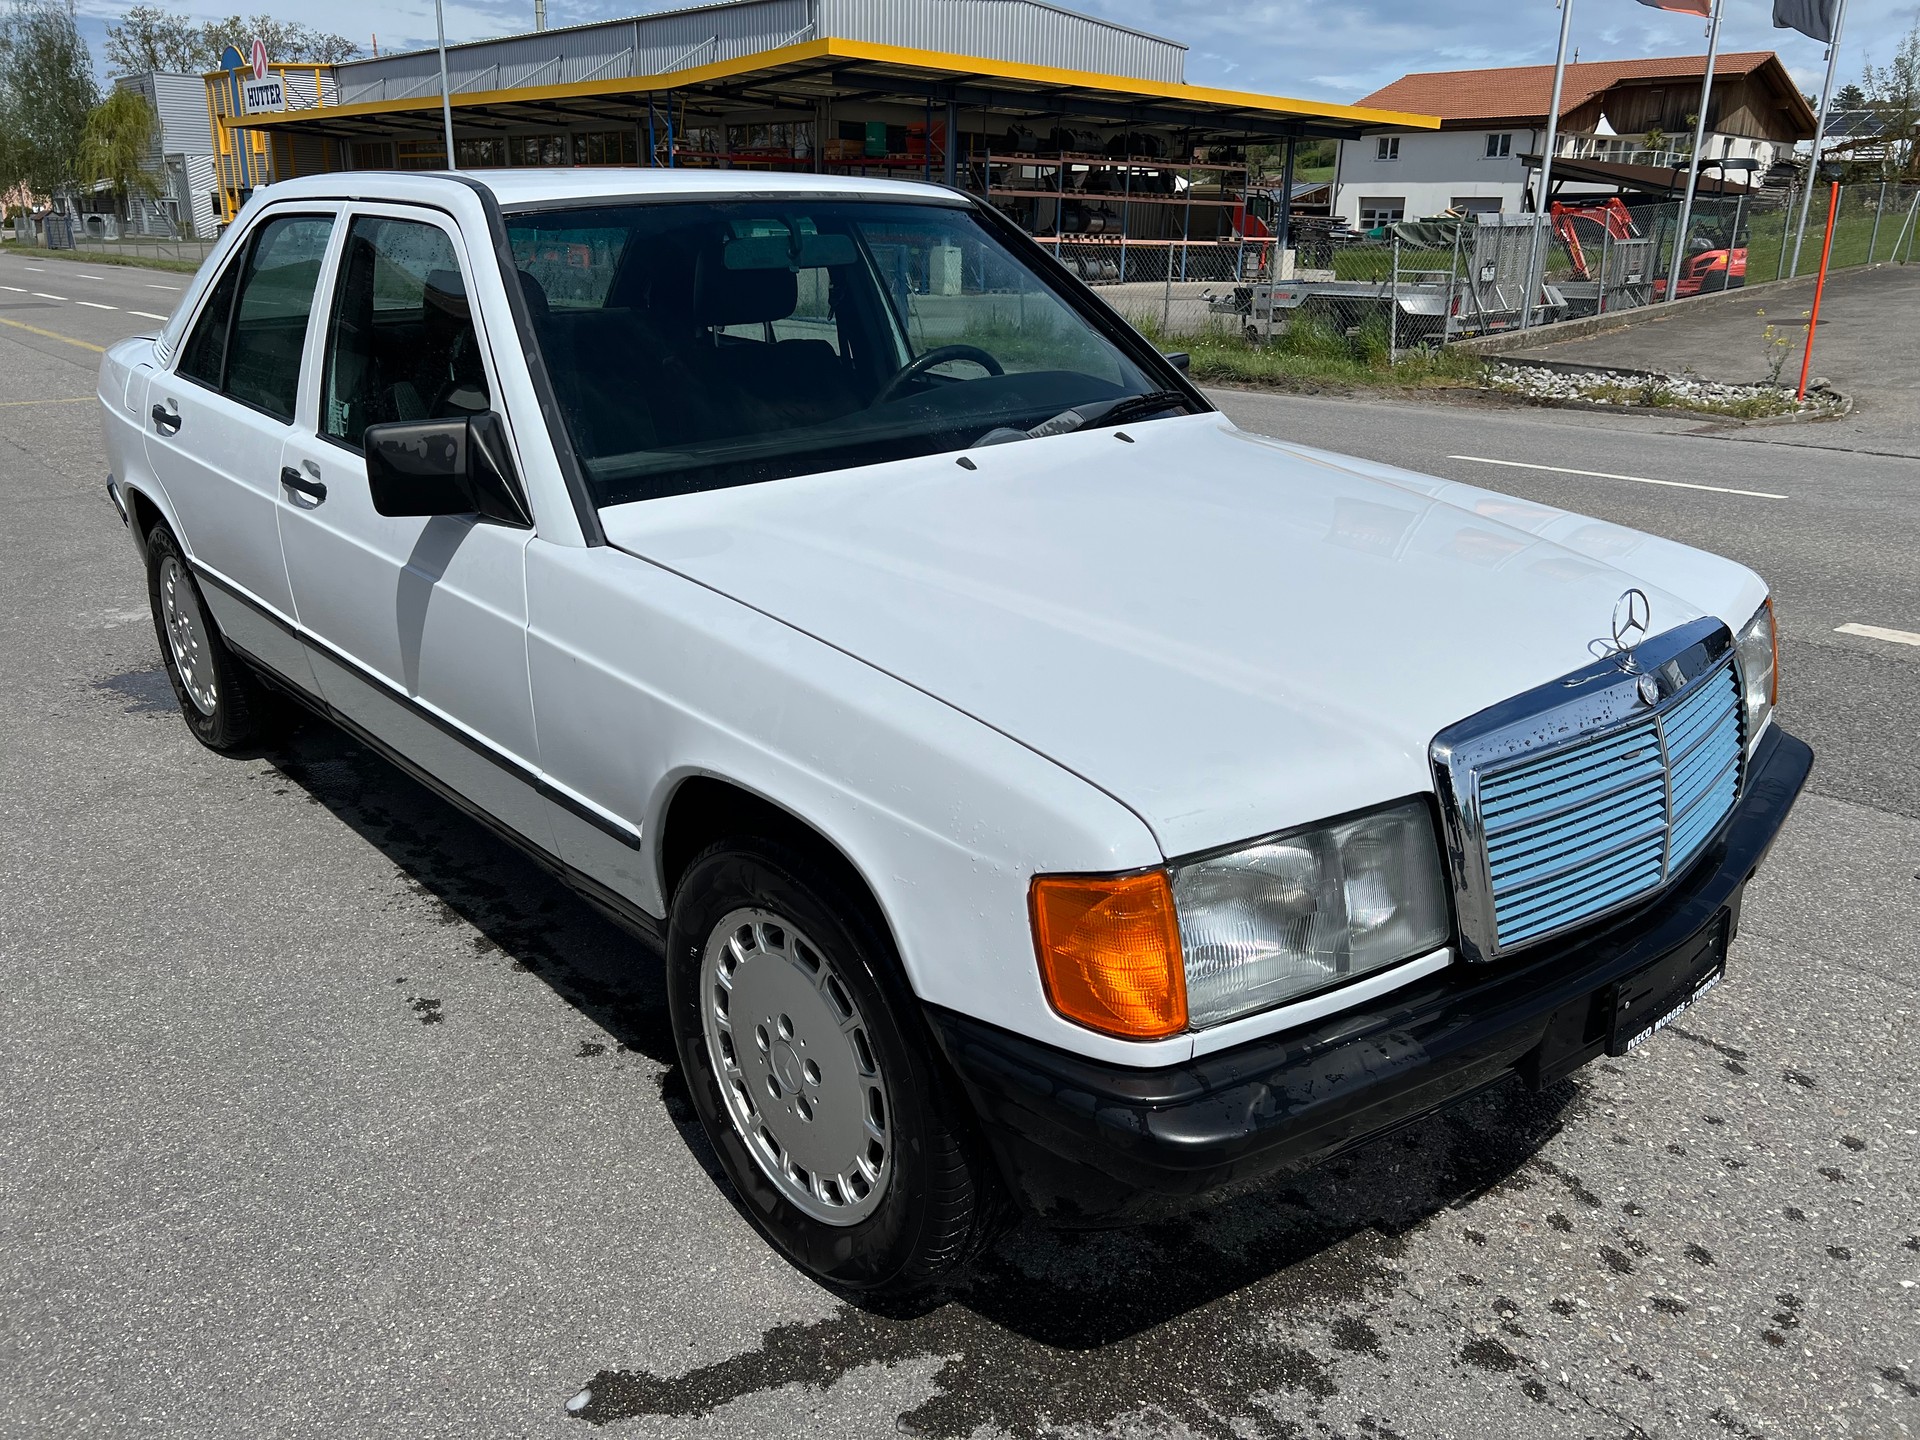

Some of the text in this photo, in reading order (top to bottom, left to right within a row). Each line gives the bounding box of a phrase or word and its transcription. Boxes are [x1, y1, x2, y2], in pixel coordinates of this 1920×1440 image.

[247, 83, 282, 107] HUTTER
[1627, 1026, 1652, 1050] IVECO
[1654, 1001, 1685, 1031] MORGES
[1691, 971, 1721, 1002] YVERDON
